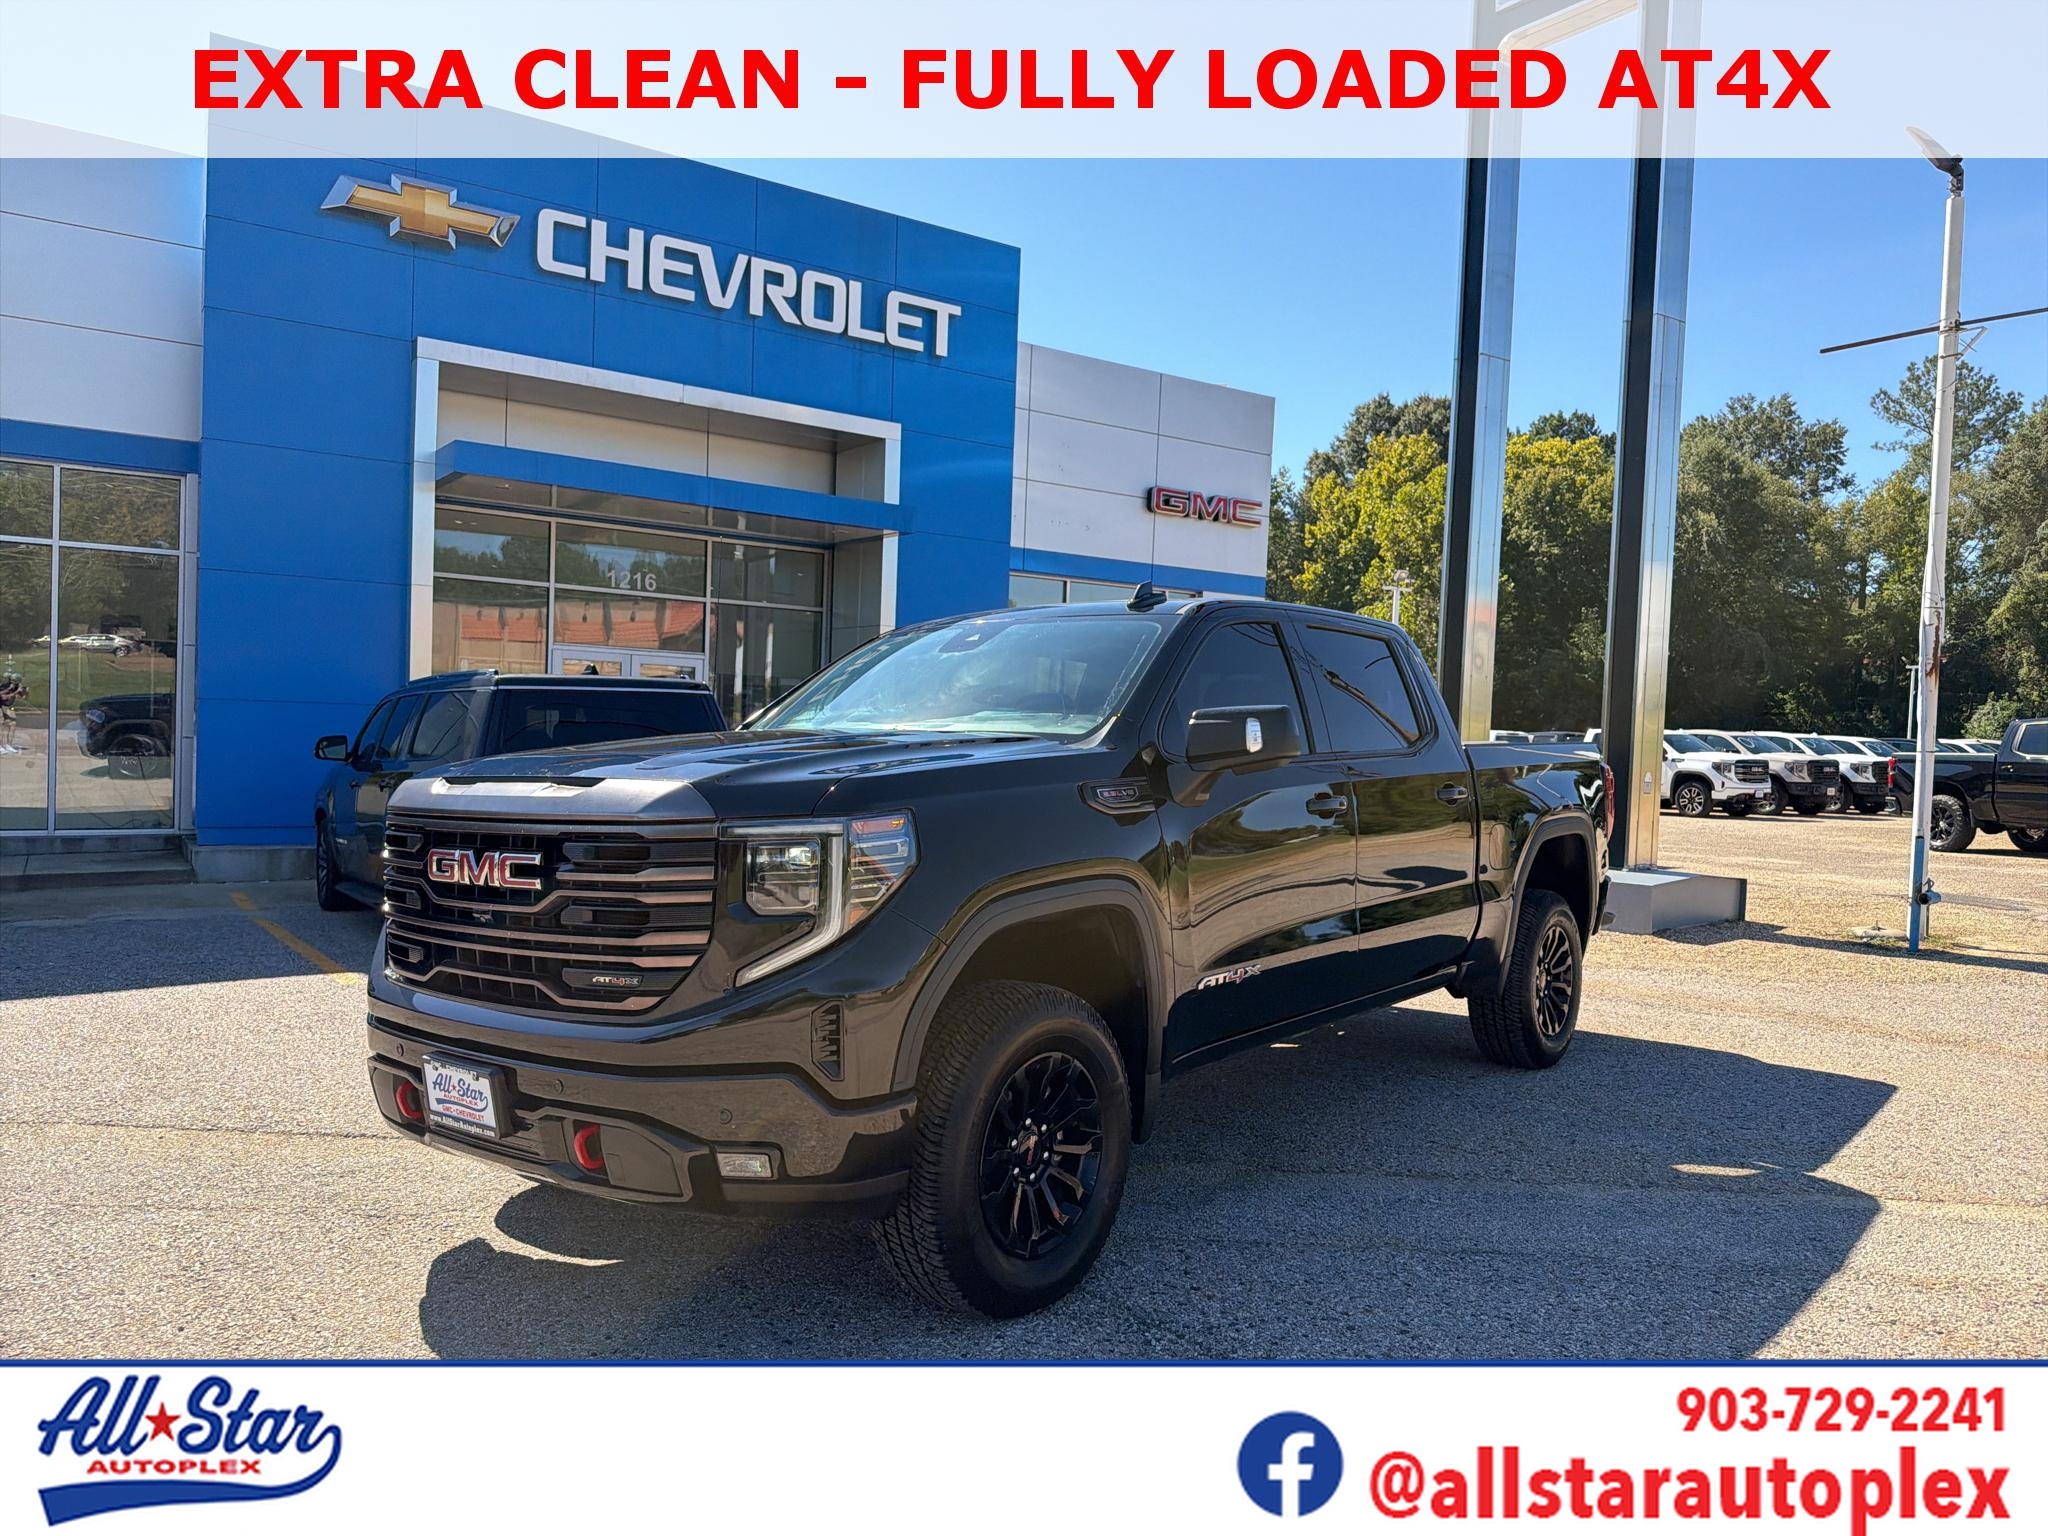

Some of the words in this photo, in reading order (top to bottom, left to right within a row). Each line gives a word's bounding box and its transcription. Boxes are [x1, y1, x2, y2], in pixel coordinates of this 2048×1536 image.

[536, 207, 962, 358] CHEVROLET
[1148, 486, 1263, 527] GMC
[607, 569, 657, 592] 1216
[428, 848, 542, 890] GMC
[592, 976, 639, 986] AT4X
[1198, 964, 1262, 991] AT4X
[432, 1072, 453, 1094] All
[457, 1077, 486, 1102] Star
